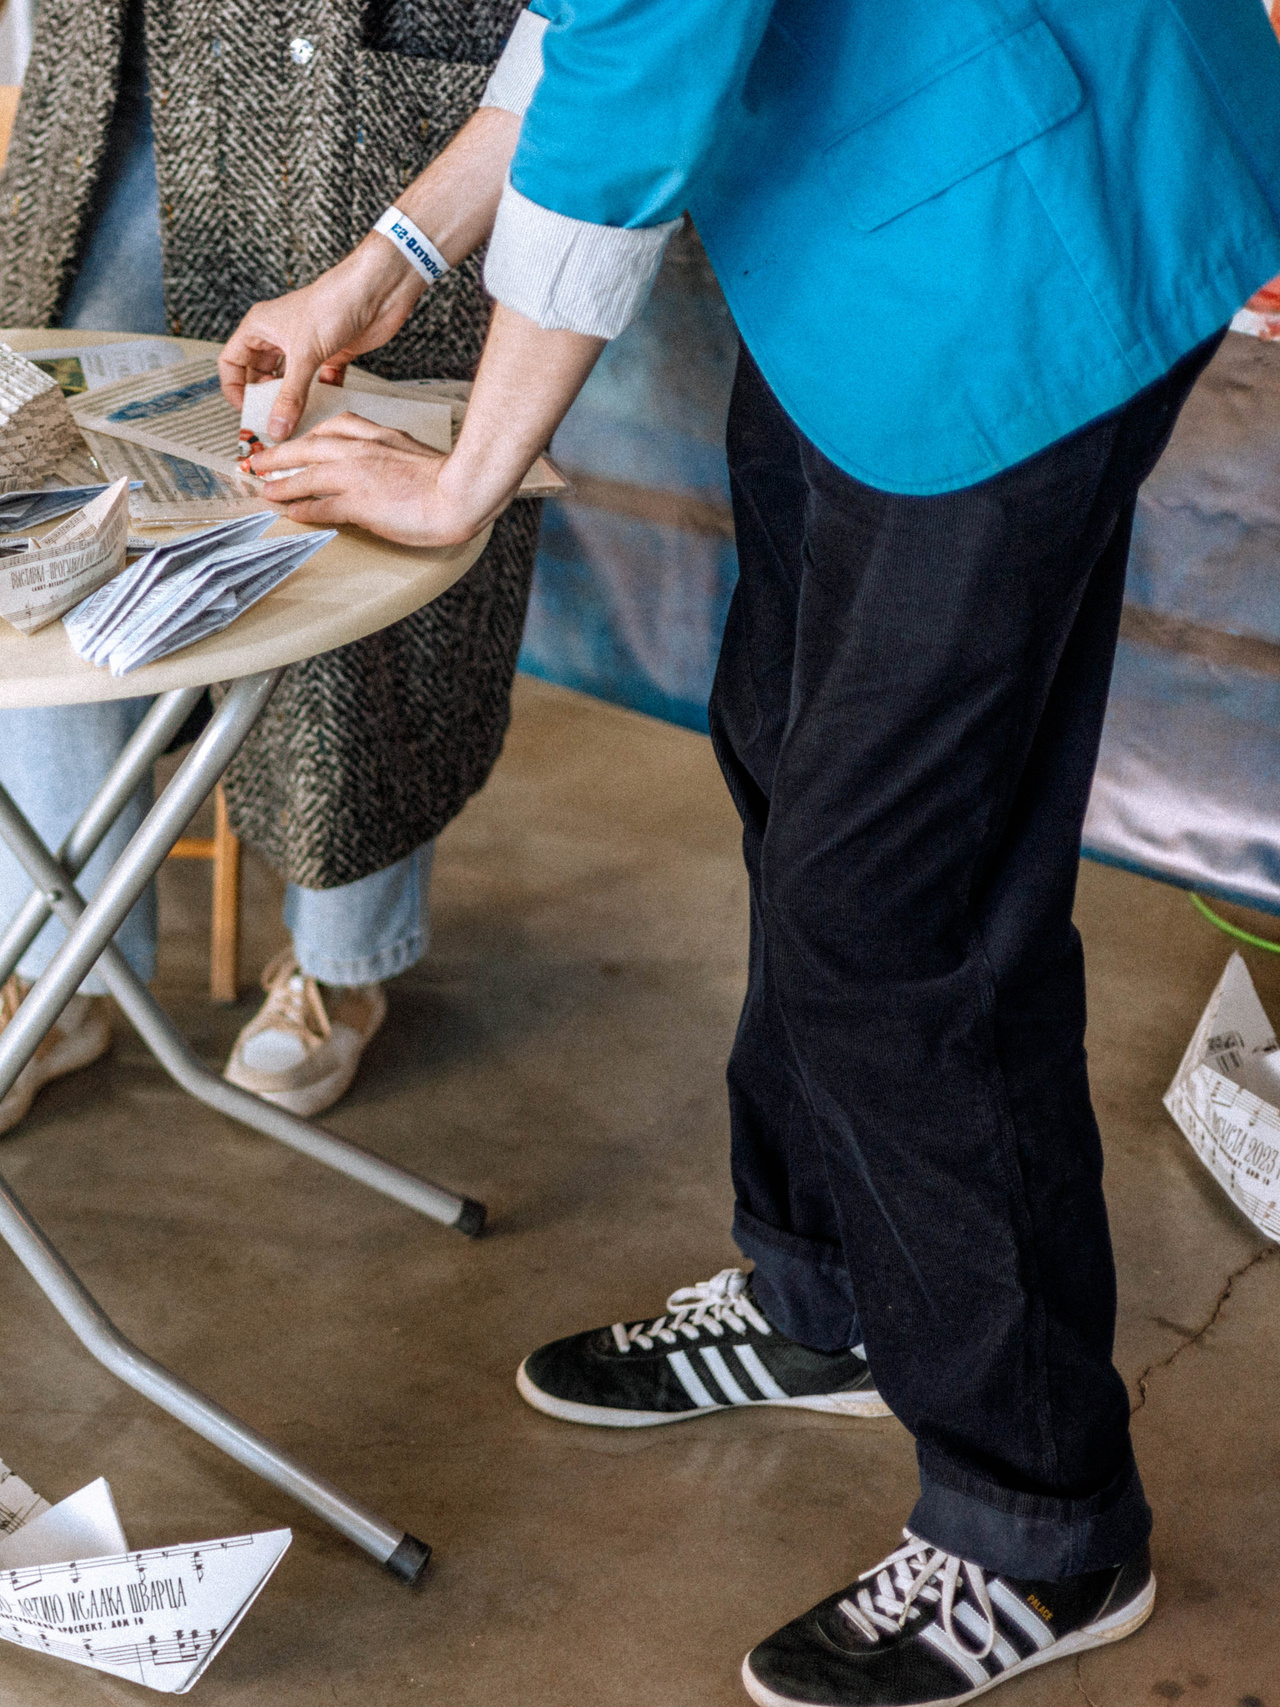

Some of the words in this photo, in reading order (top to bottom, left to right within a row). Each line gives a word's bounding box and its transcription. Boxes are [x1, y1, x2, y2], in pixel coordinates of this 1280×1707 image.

[1245, 1137, 1278, 1173] 2023
[68, 1586, 125, 1621] ИСААКА
[127, 1577, 187, 1613] ШВАРЦА
[1027, 1593, 1053, 1621] PALACE
[111, 1618, 130, 1629] ДОМ
[134, 1616, 144, 1625] 10
